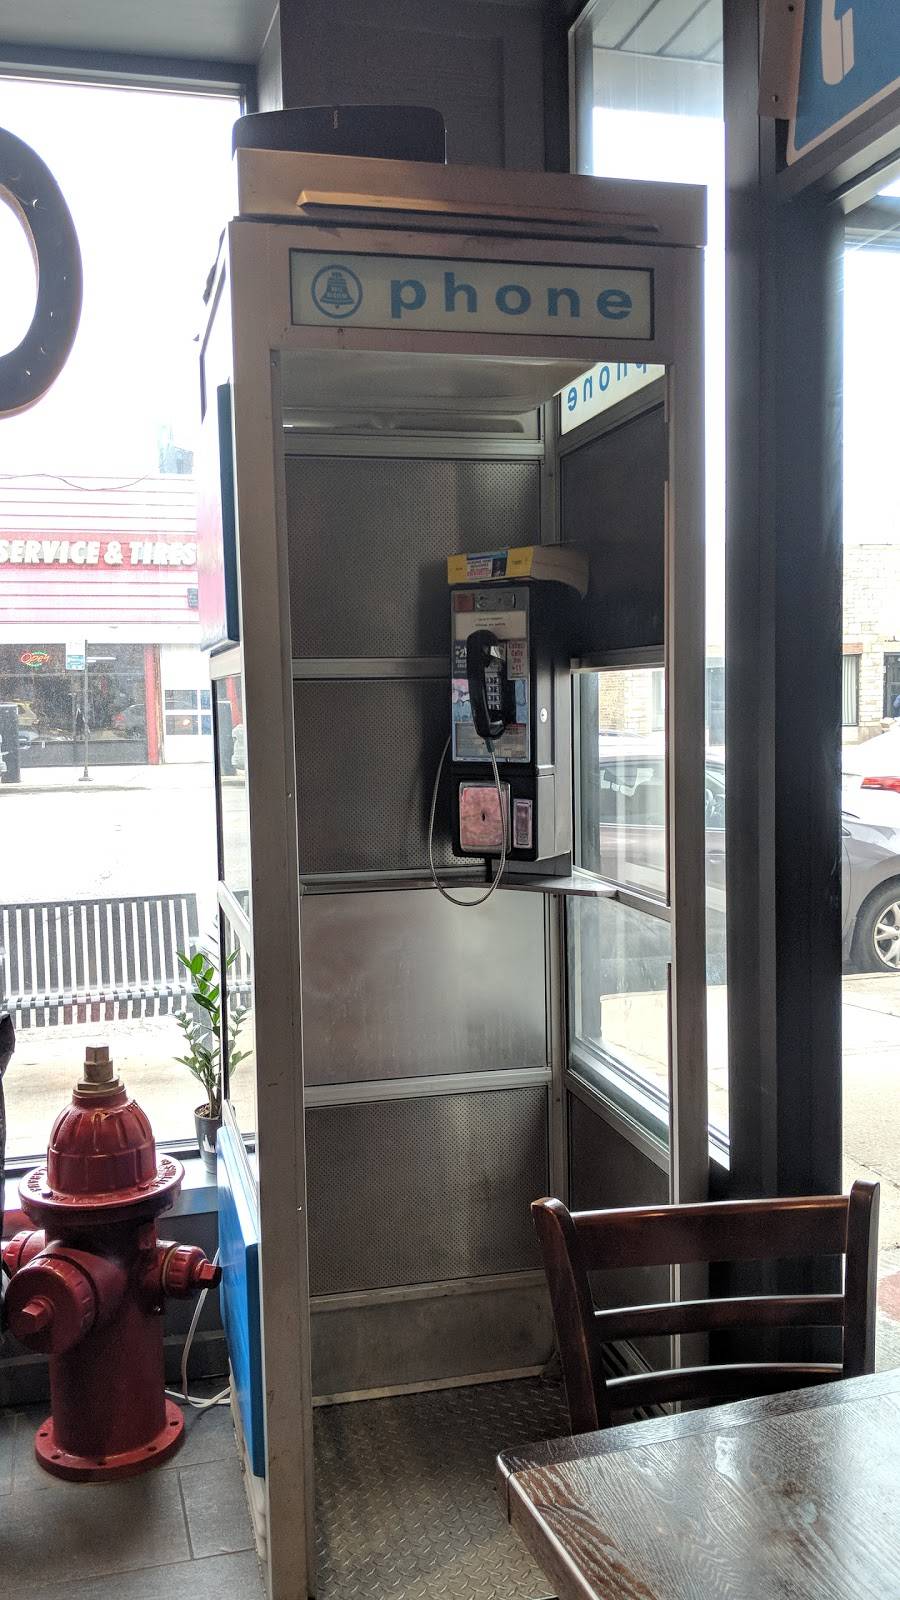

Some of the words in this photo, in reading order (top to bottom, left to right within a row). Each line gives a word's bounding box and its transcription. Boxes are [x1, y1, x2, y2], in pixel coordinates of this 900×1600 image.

[390, 271, 633, 320] phone
[0, 540, 100, 565] SERVICE
[103, 541, 123, 565] &
[129, 541, 198, 566] TIRES
